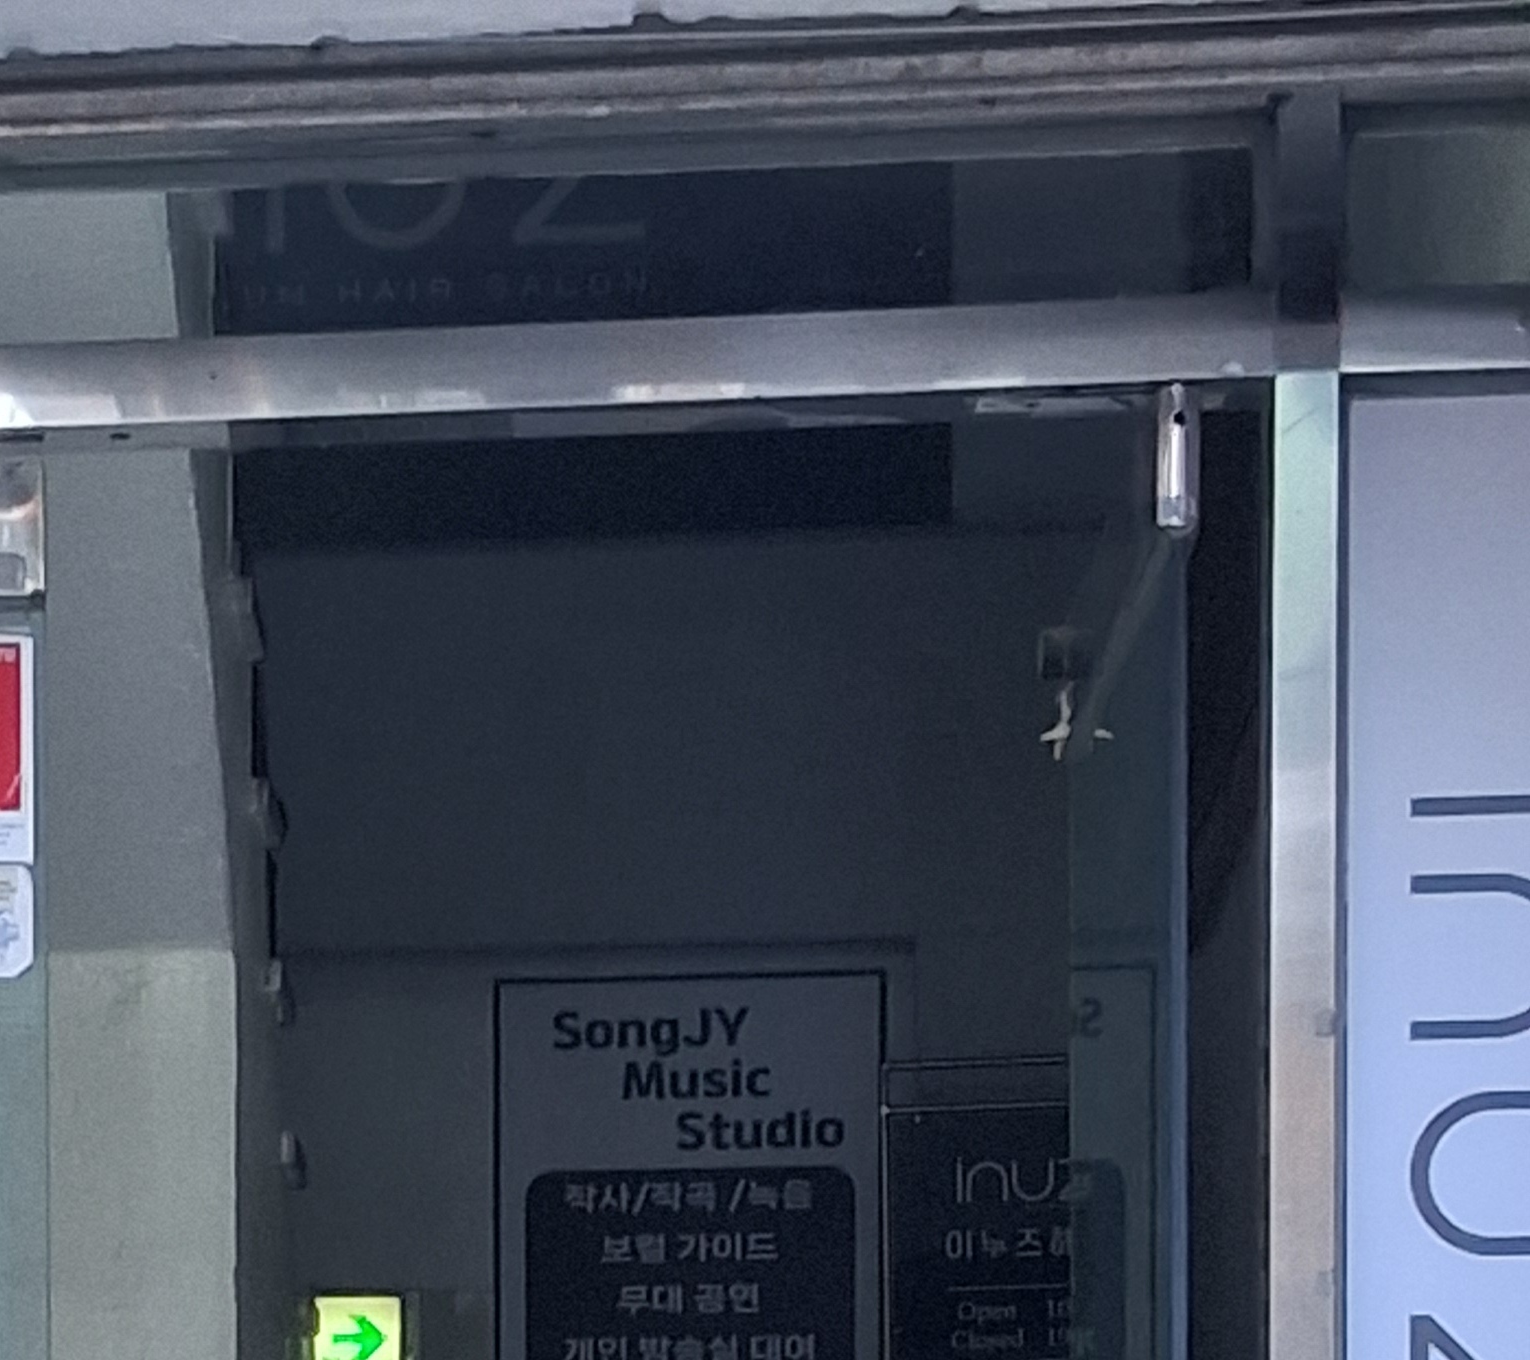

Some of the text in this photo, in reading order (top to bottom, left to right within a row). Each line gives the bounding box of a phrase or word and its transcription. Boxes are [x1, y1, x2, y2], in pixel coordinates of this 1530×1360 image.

[551, 1007, 749, 1057] SongJY
[621, 1058, 772, 1102] Music
[675, 1109, 846, 1153] Studio
[676, 1232, 778, 1263] 가이드
